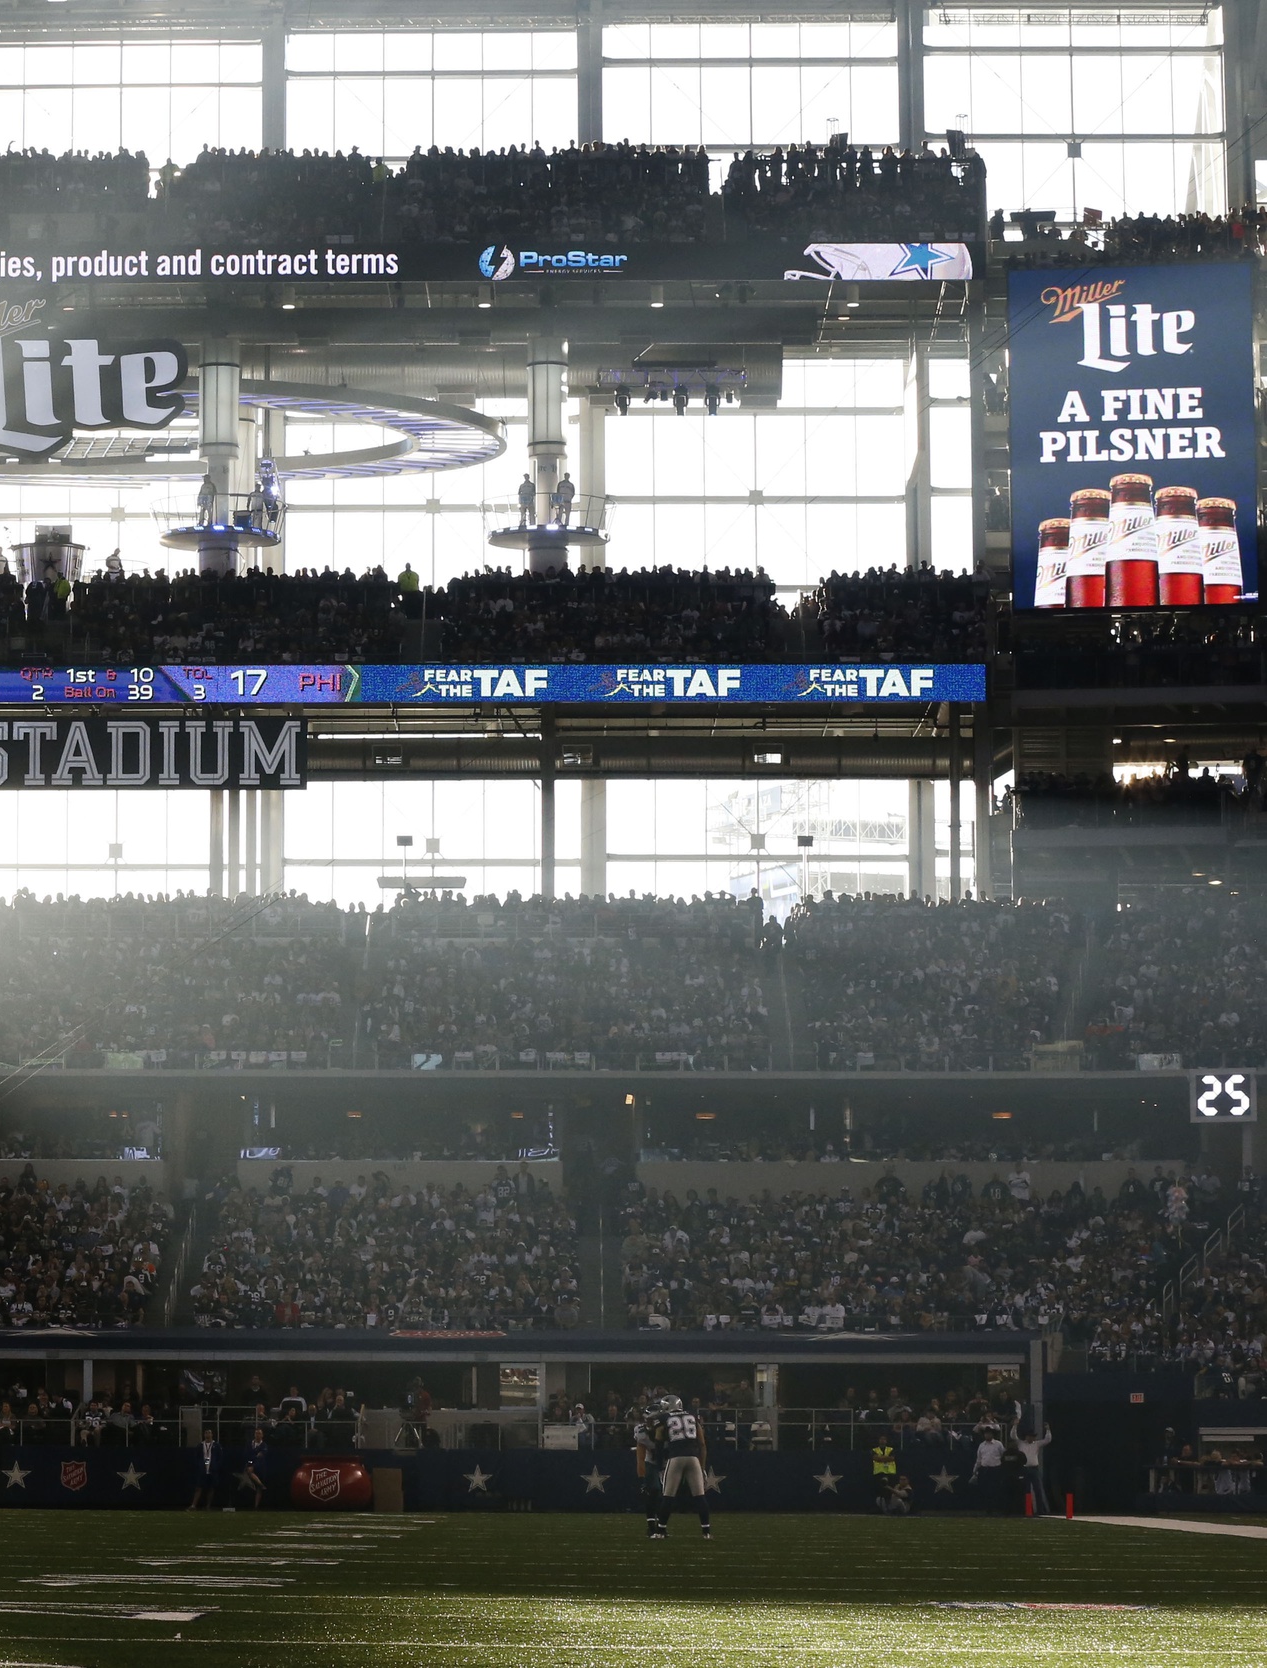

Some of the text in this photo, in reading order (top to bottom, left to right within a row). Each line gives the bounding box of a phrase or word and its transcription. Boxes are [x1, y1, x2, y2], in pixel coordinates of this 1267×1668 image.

[52, 250, 148, 282] product
[157, 249, 201, 275] and
[211, 250, 318, 275] contract
[326, 250, 398, 274] terms
[520, 251, 627, 267] ProStar
[1041, 278, 1125, 324] Miller
[1076, 303, 1196, 373] Lite
[1057, 387, 1203, 423] A FINE
[1039, 427, 1226, 463] PILSNER
[66, 668, 96, 683] 1st
[130, 667, 154, 683] 10
[231, 669, 268, 696] 17
[300, 674, 342, 691] PHI
[425, 669, 473, 684] FEAR
[474, 670, 547, 696] TAF
[618, 669, 665, 684] FEAR
[666, 670, 740, 696] TAF
[811, 669, 857, 684] FEAR
[859, 669, 933, 696] TAF
[32, 686, 45, 701] 2
[128, 685, 153, 701] 39
[194, 685, 206, 701] 3
[439, 684, 473, 698] THE
[631, 684, 666, 698] THE
[824, 684, 858, 698] THE
[1197, 1074, 1250, 1117] 25
[667, 1414, 697, 1442] 26
